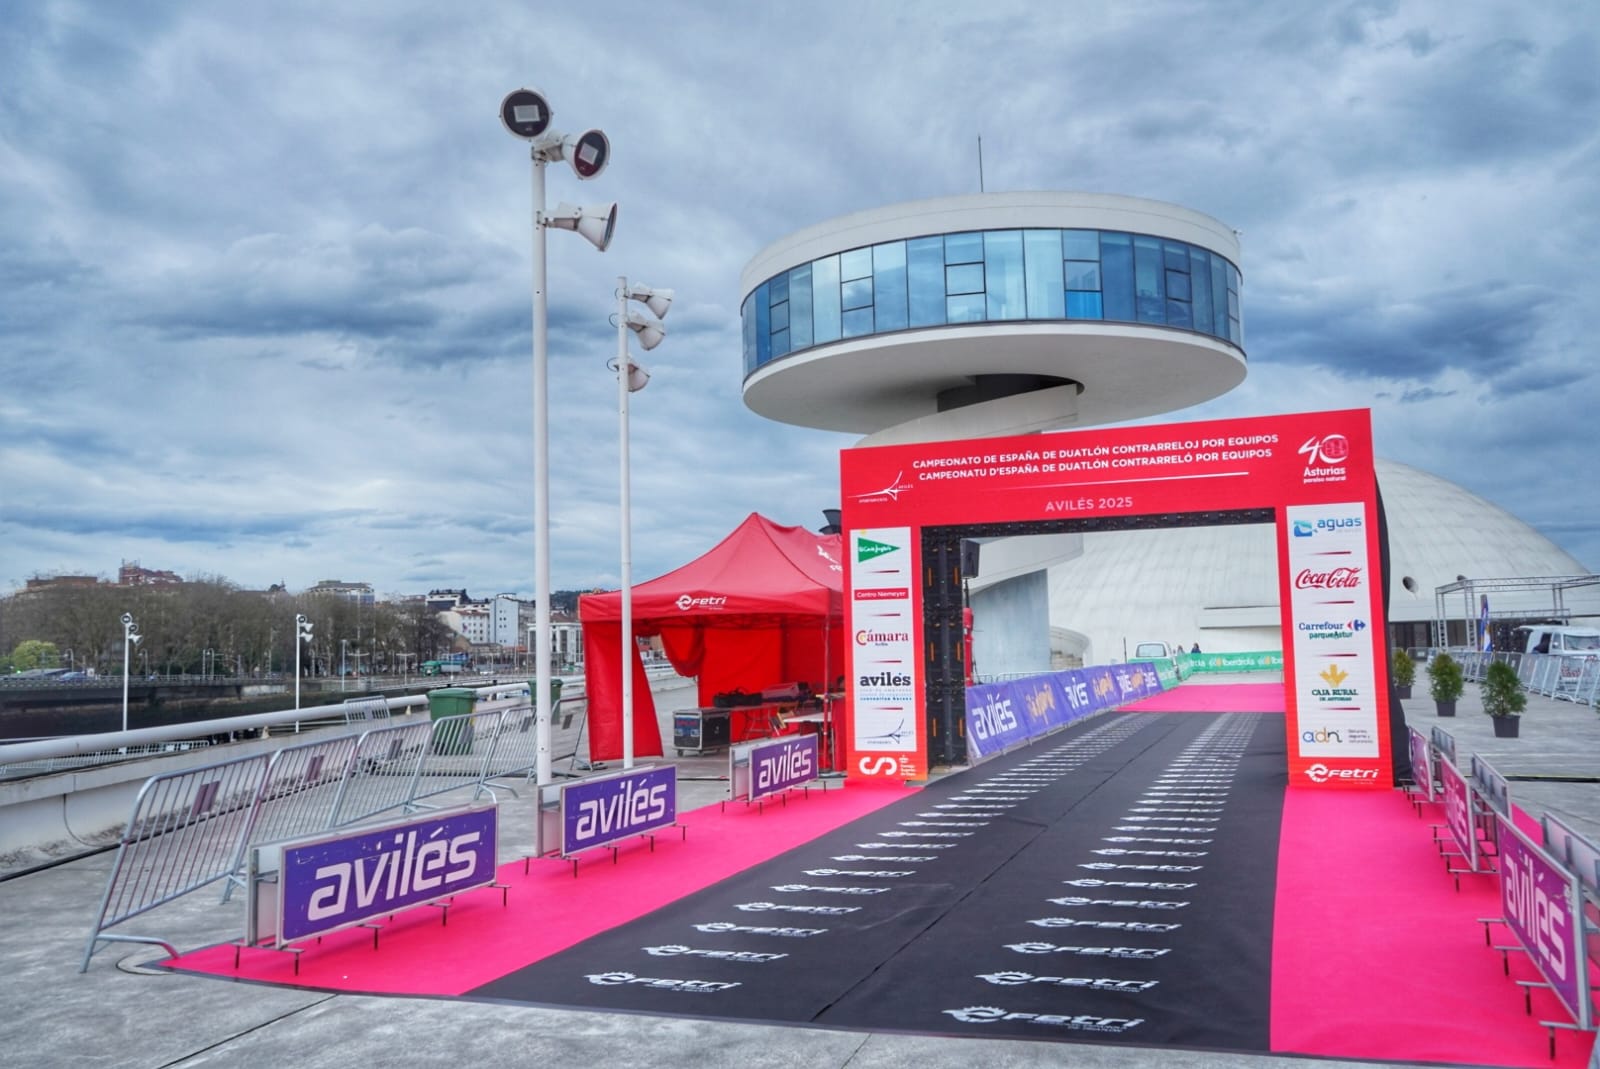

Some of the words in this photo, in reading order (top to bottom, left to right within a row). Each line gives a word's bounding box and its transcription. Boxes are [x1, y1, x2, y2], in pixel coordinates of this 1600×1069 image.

[912, 456, 981, 469] CAMPEONATO
[983, 455, 997, 464] DE
[999, 450, 1040, 463] ESPAÑA
[1042, 451, 1057, 460] DE
[1059, 446, 1110, 458] DUATLÓN
[1112, 440, 1199, 455] CONTRARRELOJ
[1202, 439, 1225, 449] POR
[1228, 434, 1279, 447] EQUIPOS
[919, 468, 987, 481] CAMPEONATU
[989, 464, 1040, 477] D'ESPAÑA
[1042, 463, 1056, 473] DE
[1058, 459, 1109, 472] DUATLÓN
[1111, 453, 1193, 468] CONTRARRELÓ
[1196, 452, 1219, 462] POR
[1222, 448, 1272, 461] EQUIPOS
[1303, 466, 1346, 477] Asturias
[1045, 497, 1095, 512] AVILÉS
[1098, 496, 1134, 509] 2025
[1317, 517, 1362, 531] aguas
[1295, 567, 1362, 590] Coca-Cola
[857, 591, 876, 599] Centro
[877, 590, 906, 598] Niemeyer
[1299, 621, 1344, 631] Carrefour
[856, 628, 908, 646] Cámara
[860, 672, 911, 687] avilés
[971, 693, 1018, 741] avilés
[1302, 726, 1342, 743] adn
[758, 743, 812, 789] avilés
[1328, 768, 1380, 778] fetri
[575, 778, 667, 841] avilés
[307, 826, 481, 921] avilés
[1505, 853, 1566, 981] avilés
